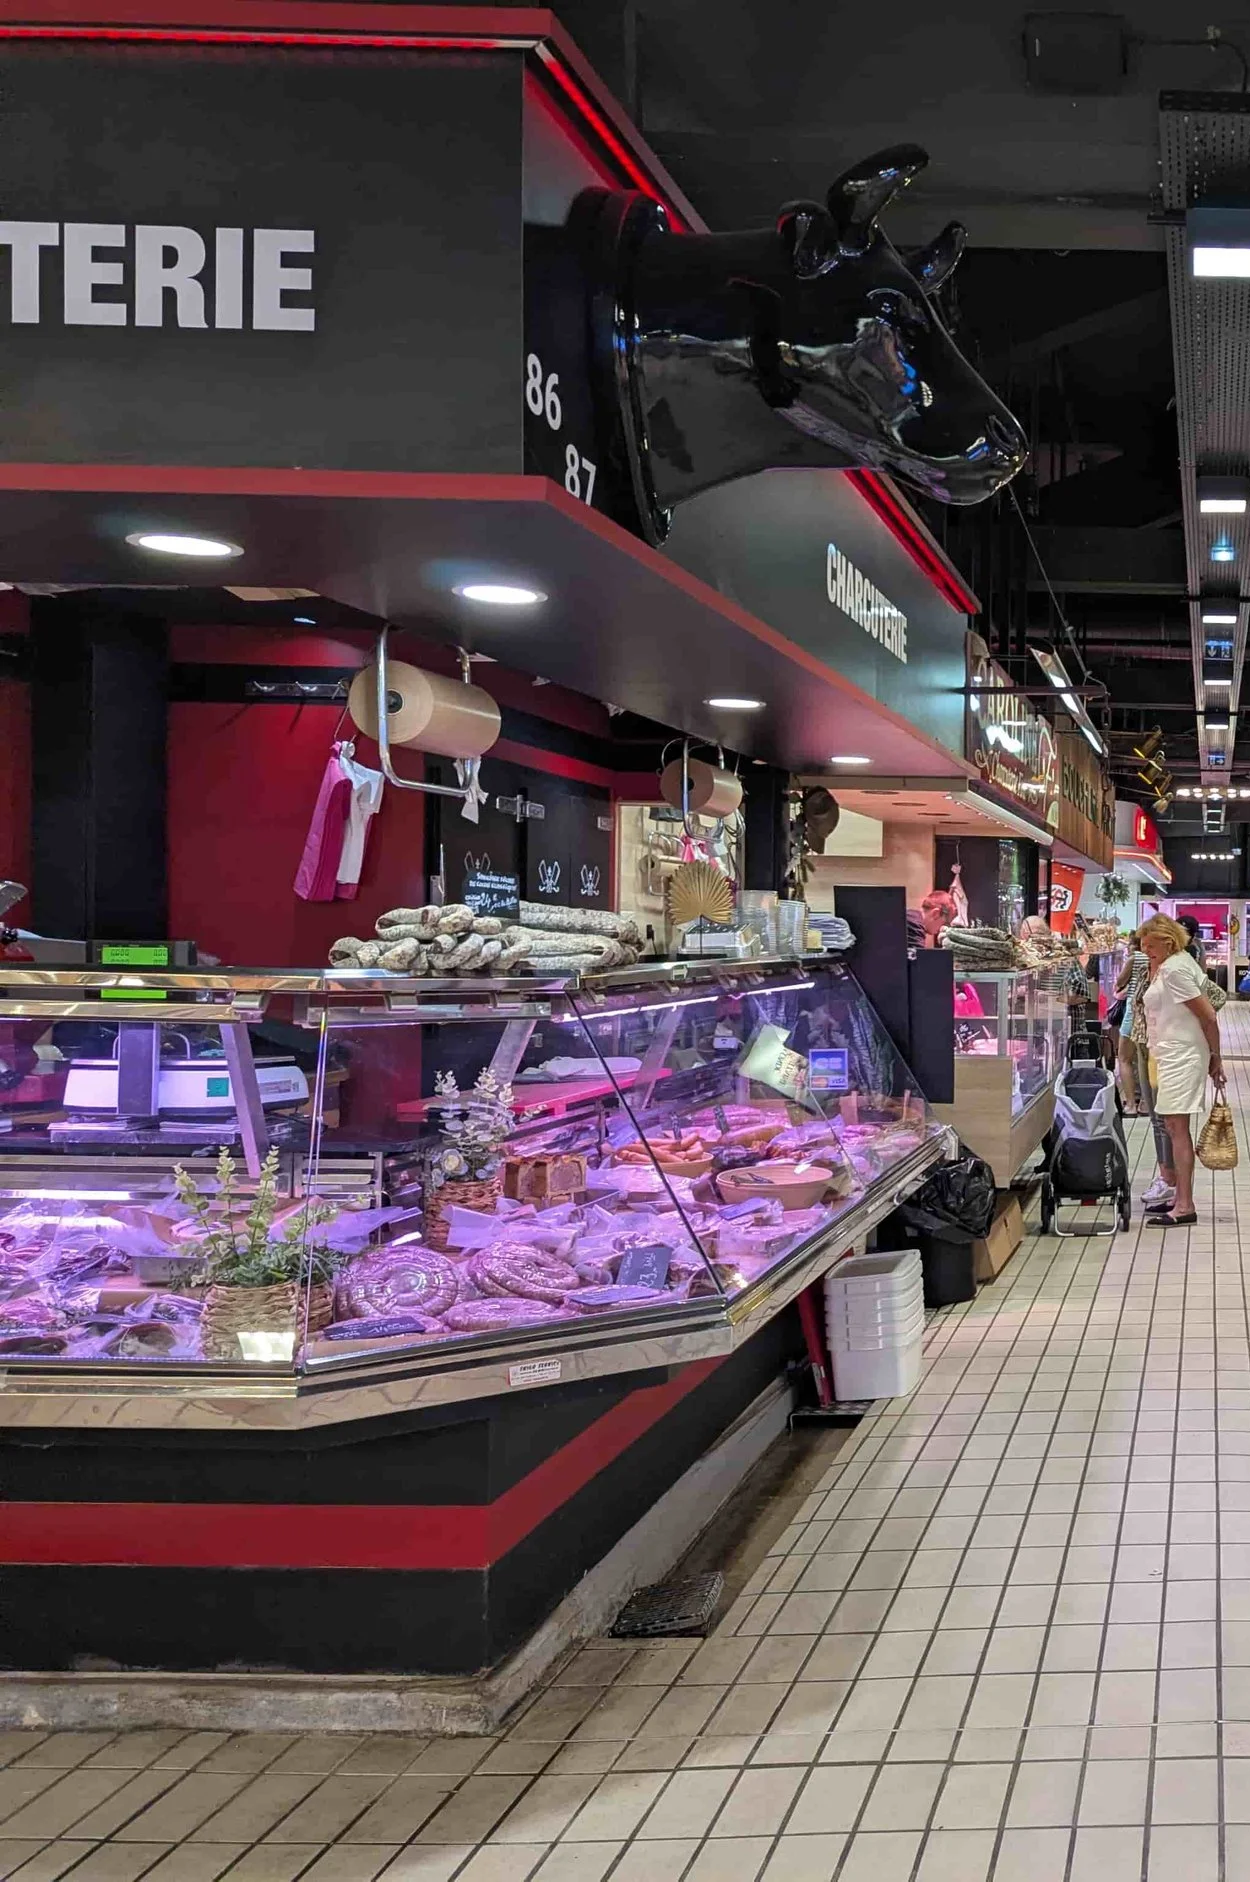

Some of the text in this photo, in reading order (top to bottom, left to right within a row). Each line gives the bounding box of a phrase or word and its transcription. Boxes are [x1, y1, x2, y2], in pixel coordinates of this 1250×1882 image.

[0, 220, 315, 331] TERIE
[526, 353, 562, 430] 86
[565, 444, 596, 506] 87
[827, 543, 907, 664] CHARCUTERIE
